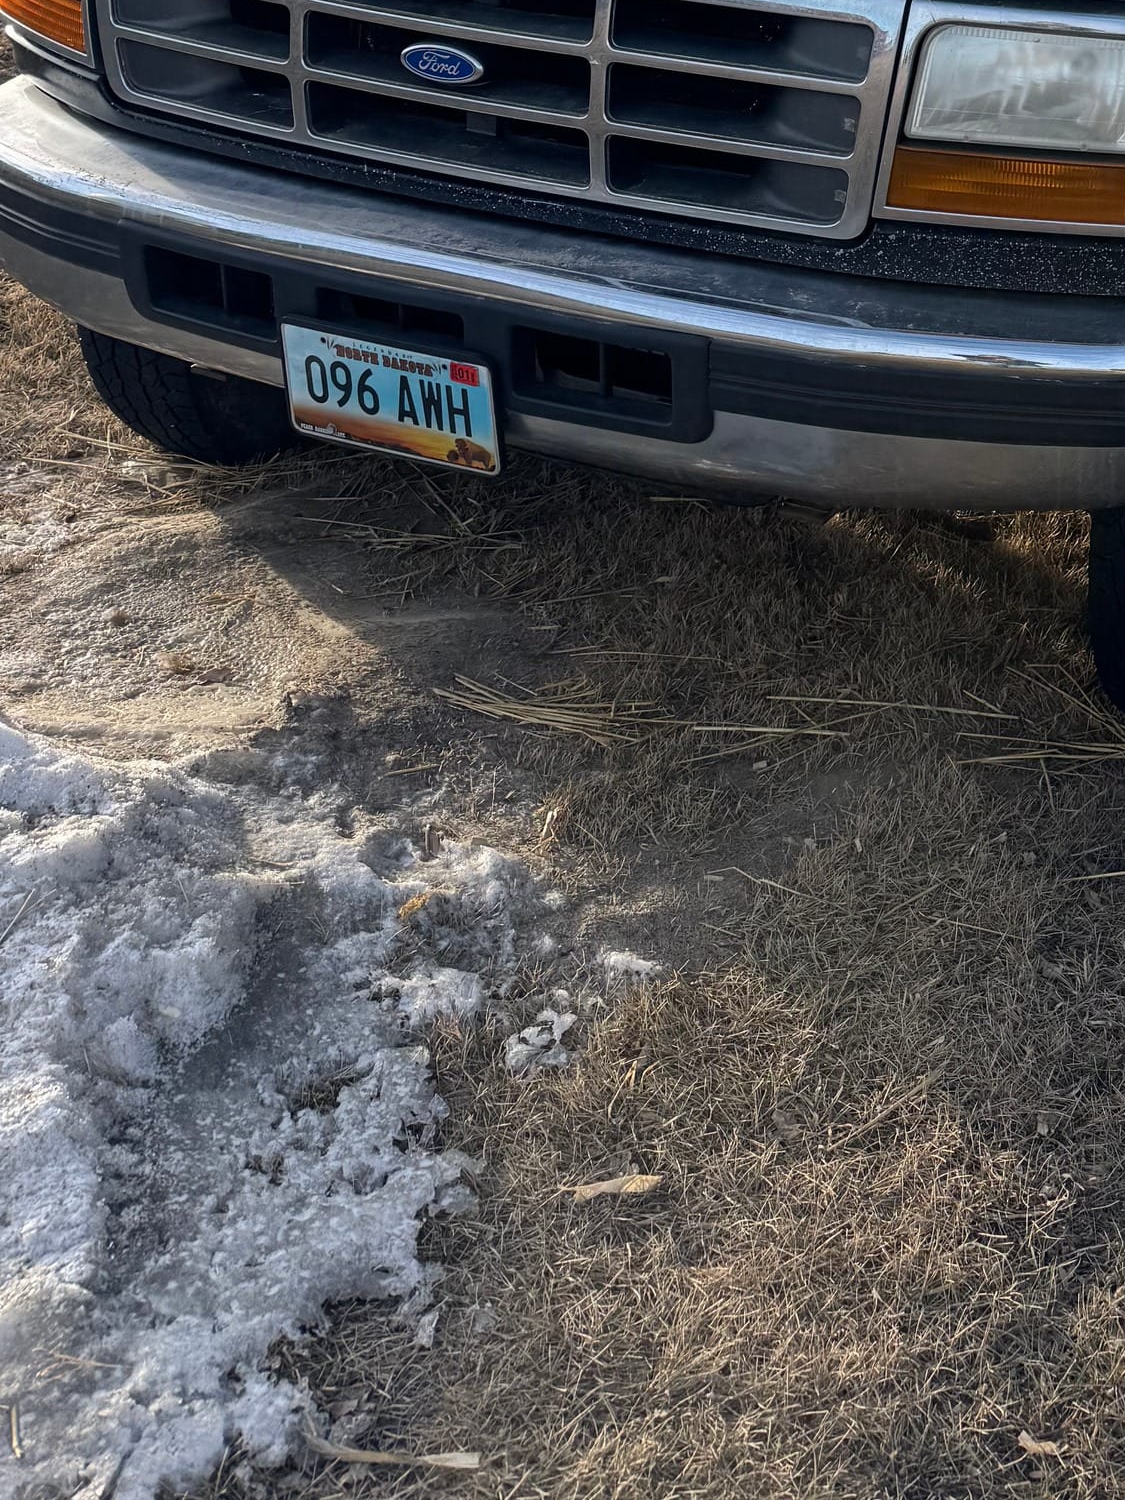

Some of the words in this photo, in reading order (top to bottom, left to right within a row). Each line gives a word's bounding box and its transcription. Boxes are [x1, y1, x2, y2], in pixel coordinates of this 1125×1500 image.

[418, 51, 461, 76] Ford
[333, 344, 380, 366] NORTH
[382, 354, 434, 377] DAKOTA
[304, 354, 381, 416] 096
[397, 375, 473, 438] AWH
